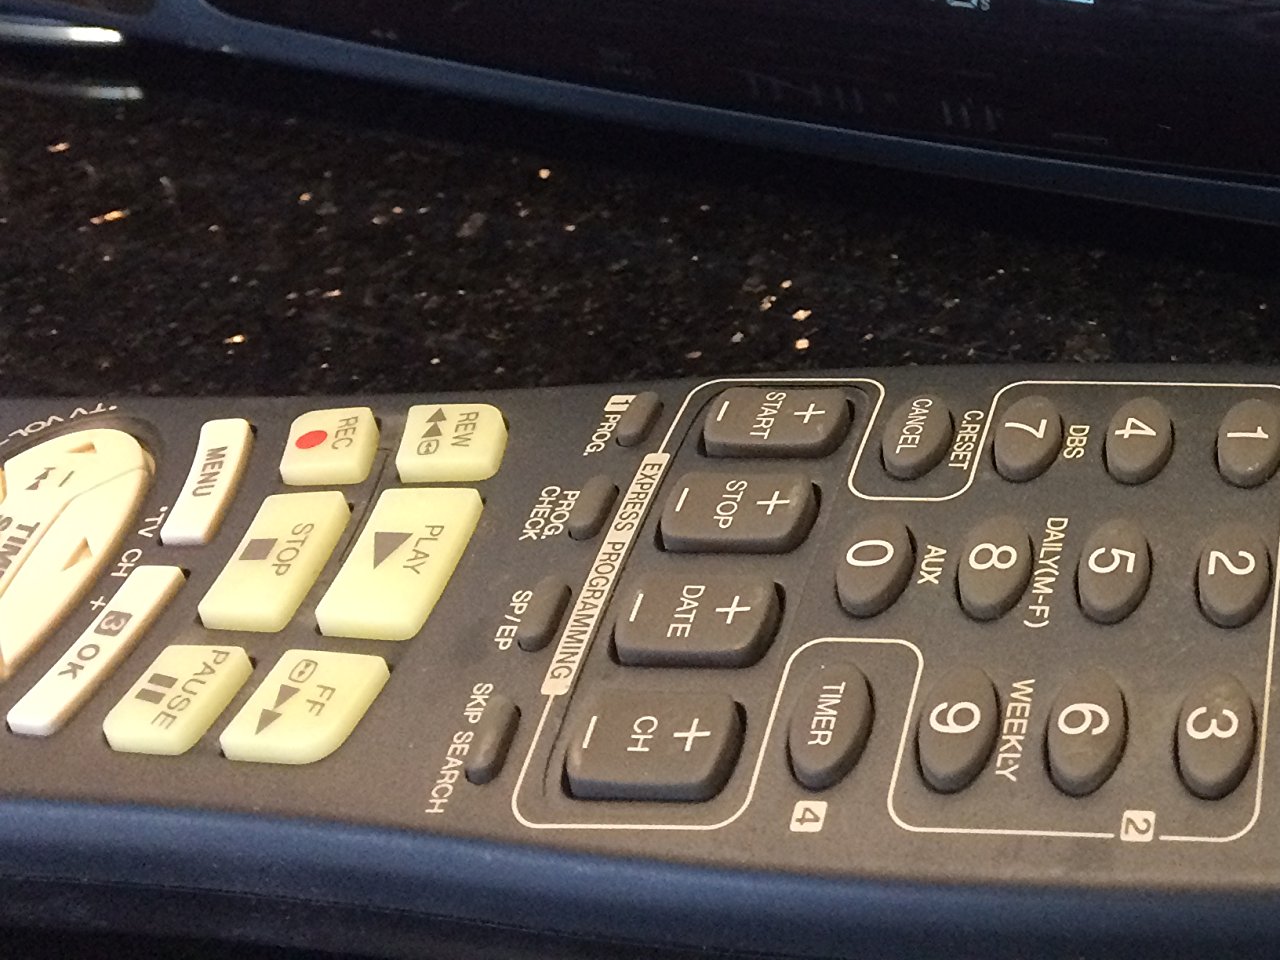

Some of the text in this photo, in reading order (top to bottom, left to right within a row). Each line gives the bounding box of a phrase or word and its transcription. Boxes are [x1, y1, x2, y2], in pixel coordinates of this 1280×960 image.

[8, 415, 64, 437] VOL
[331, 415, 359, 451] REC
[450, 410, 480, 448] REW
[583, 413, 620, 457] PROG.
[749, 391, 787, 440] START
[895, 398, 933, 454] CANCEL
[1004, 418, 1048, 440] 7
[1114, 417, 1157, 440] 4
[1226, 425, 1269, 440] 1
[948, 410, 985, 471] C.RESET
[1063, 424, 1090, 459] DBS
[192, 446, 228, 498] MENU
[518, 485, 562, 541] CHECK
[540, 489, 580, 540] PROG.
[713, 479, 748, 529] STOP
[110, 514, 165, 579] TV CH
[271, 523, 315, 577] STOP
[402, 524, 445, 575] PLAY
[846, 539, 895, 568] 0
[916, 543, 947, 585] AUX
[968, 542, 1018, 571] 8
[1088, 547, 1136, 574] 5
[1207, 550, 1256, 576] 2
[550, 462, 663, 681] EXPRESS PROGRAMMING
[1023, 516, 1069, 629] DAILY(M-F)
[493, 589, 533, 651] SP/EP
[666, 584, 706, 638] DATE
[57, 643, 100, 680] OK
[150, 649, 231, 730] PAUSE
[306, 683, 337, 717] FF
[626, 715, 659, 752] CH
[807, 681, 847, 747] TIMER
[929, 701, 982, 734] 9
[994, 678, 1036, 783] WEEKLY
[1057, 702, 1111, 736] 6
[1185, 706, 1239, 740] 3
[425, 682, 494, 814] SKIP SEARCH
